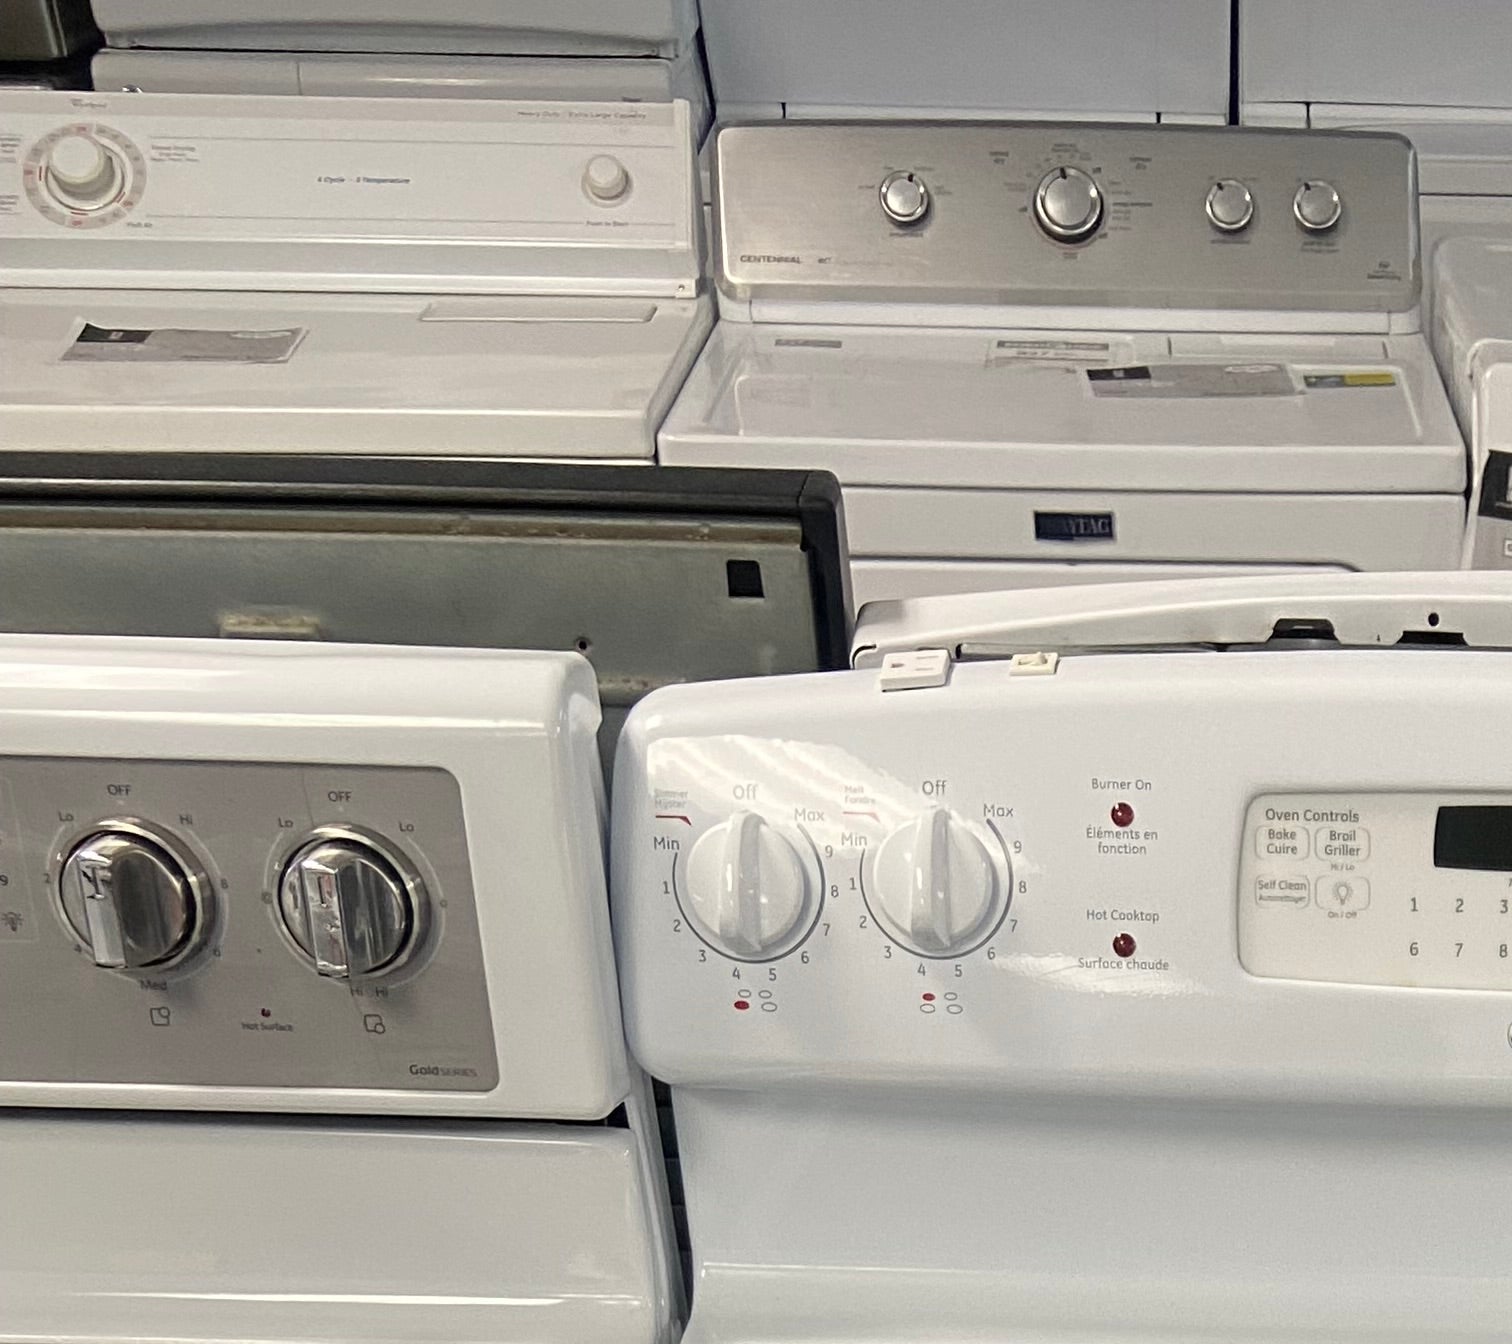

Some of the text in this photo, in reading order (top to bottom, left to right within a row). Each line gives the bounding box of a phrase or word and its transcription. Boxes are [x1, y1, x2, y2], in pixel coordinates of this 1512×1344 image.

[107, 784, 132, 796] OFF
[922, 780, 947, 795] Off
[1091, 778, 1152, 791] Burner On
[328, 791, 352, 803] OFF
[733, 785, 759, 800] Off
[58, 811, 74, 823] Lo
[795, 808, 824, 821] Max
[983, 804, 1014, 817] Max
[1265, 808, 1360, 823] Oven Controls
[180, 814, 193, 825] Hi
[278, 817, 294, 829] Lo
[400, 822, 414, 833] Lo
[1086, 824, 1158, 841] Éléments en
[841, 832, 868, 846] Min
[1267, 829, 1297, 841] Bake
[1329, 830, 1357, 842] Broil
[654, 836, 680, 850] Min
[1014, 841, 1022, 853] 9
[1097, 842, 1147, 856] fonction
[1266, 843, 1298, 855] Cuire
[825, 845, 833, 858] 9
[1324, 844, 1361, 857] Griller
[664, 881, 670, 894] 1
[850, 878, 857, 890] 1
[1019, 881, 1027, 893] 8
[1258, 880, 1307, 891] Self Clean
[831, 885, 839, 898] 8
[1410, 897, 1420, 912] 1
[1455, 898, 1465, 913] 2
[1499, 900, 1509, 915] 3
[859, 916, 867, 928] 2
[1086, 909, 1160, 925] Hot Cooktop
[673, 920, 681, 932] 2
[823, 924, 830, 936] 7
[1010, 920, 1017, 932] 7
[699, 950, 706, 962] 3
[884, 947, 892, 958] 3
[988, 948, 995, 960] 6
[1410, 942, 1420, 957] 6
[1455, 943, 1465, 958] 7
[1499, 944, 1509, 959] 8
[801, 951, 809, 964] 6
[1078, 957, 1170, 971] Surface chaude
[732, 968, 740, 979] 4
[769, 968, 777, 981] 5
[918, 964, 926, 976] 4
[955, 965, 962, 977] 5
[141, 978, 168, 991] Med
